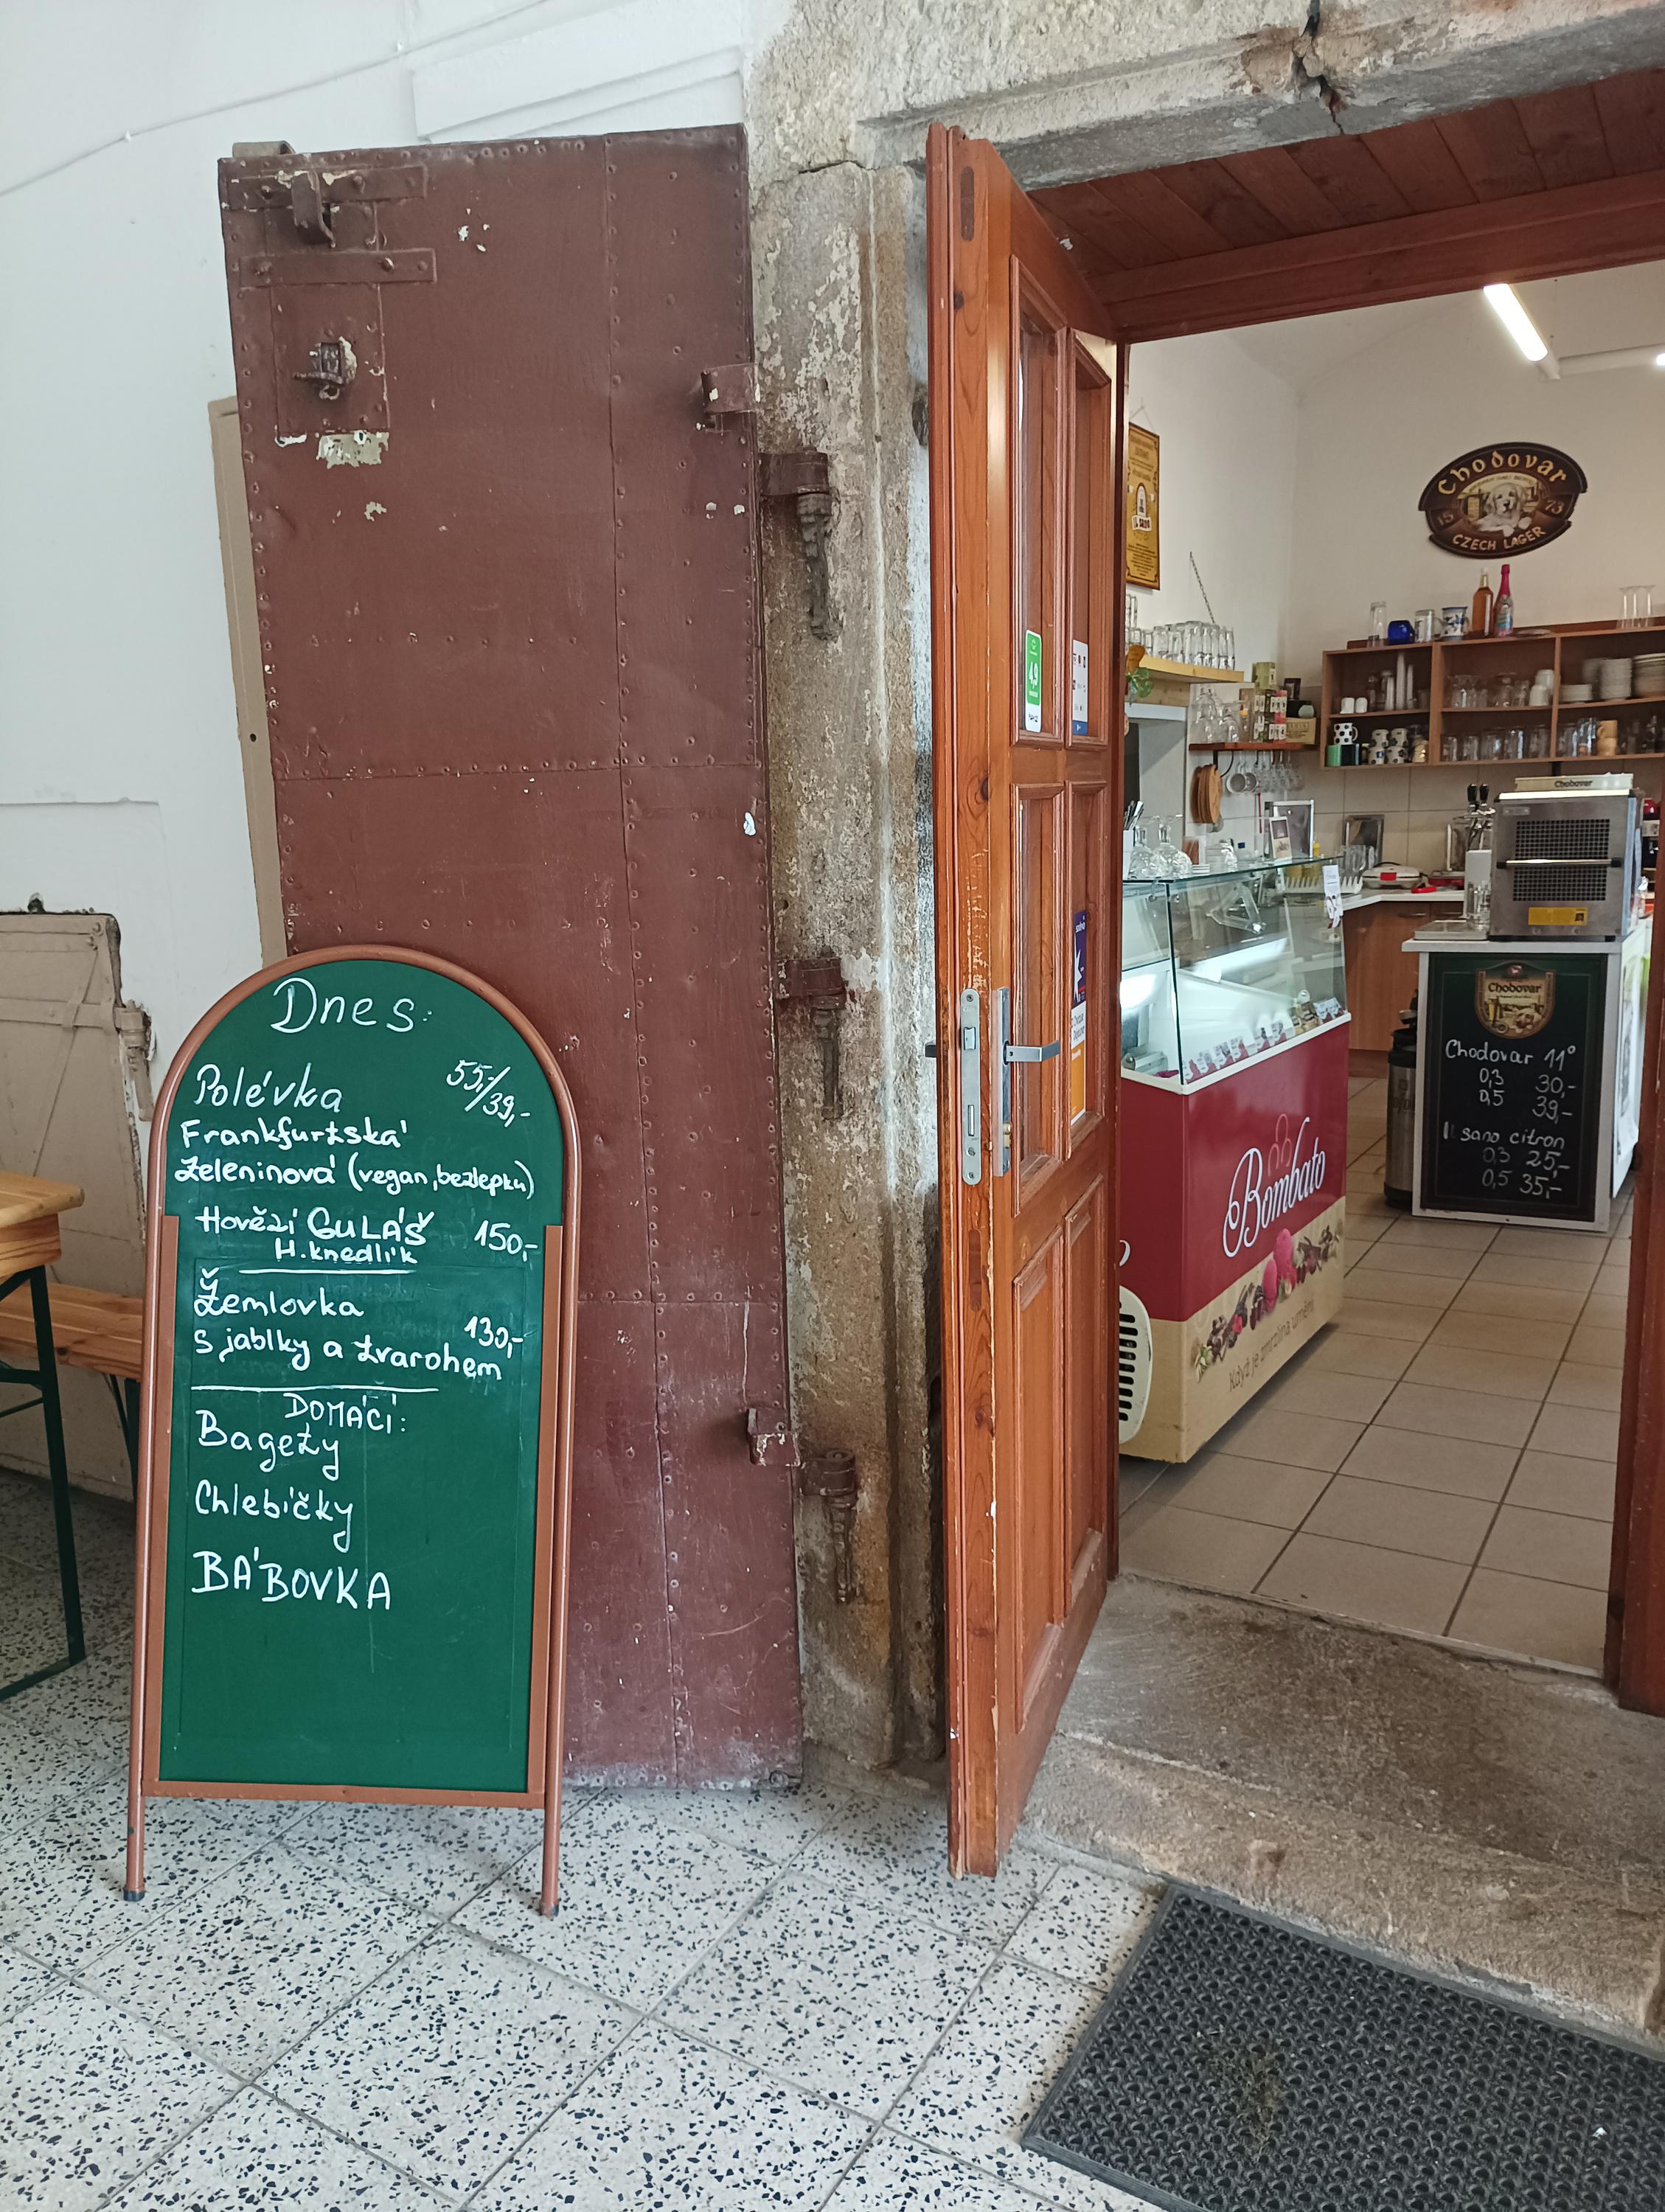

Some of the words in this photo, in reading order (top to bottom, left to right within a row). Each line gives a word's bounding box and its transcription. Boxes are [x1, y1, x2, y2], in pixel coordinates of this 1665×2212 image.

[1438, 451, 1566, 496] Chodovar
[1545, 500, 1565, 515] 73
[1453, 534, 1496, 551] CZECH
[1504, 526, 1546, 550] LAGER
[1487, 982, 1542, 993] Chodovar
[1445, 1039, 1533, 1065] Chodovar
[194, 1062, 343, 1113] Polévka
[1479, 1068, 1504, 1088] 0,3
[1479, 1089, 1505, 1106] 0,5
[180, 1116, 407, 1150] Frankfurtská
[1460, 1127, 1500, 1143] sano
[1509, 1129, 1565, 1150] citron
[174, 1155, 336, 1184] Zeleninová
[1481, 1169, 1512, 1189] 0,5
[1223, 1116, 1326, 1258] Bombato
[195, 1206, 299, 1234] Hovězí
[307, 1206, 435, 1246] GULÁŠ
[219, 1328, 310, 1371] jablky
[323, 1341, 344, 1359] a
[351, 1334, 503, 1380] tvarohem
[195, 1409, 339, 1481] Bagety
[195, 1479, 353, 1553] Chlebíčky
[191, 1547, 392, 1610] BÁBOVKA
